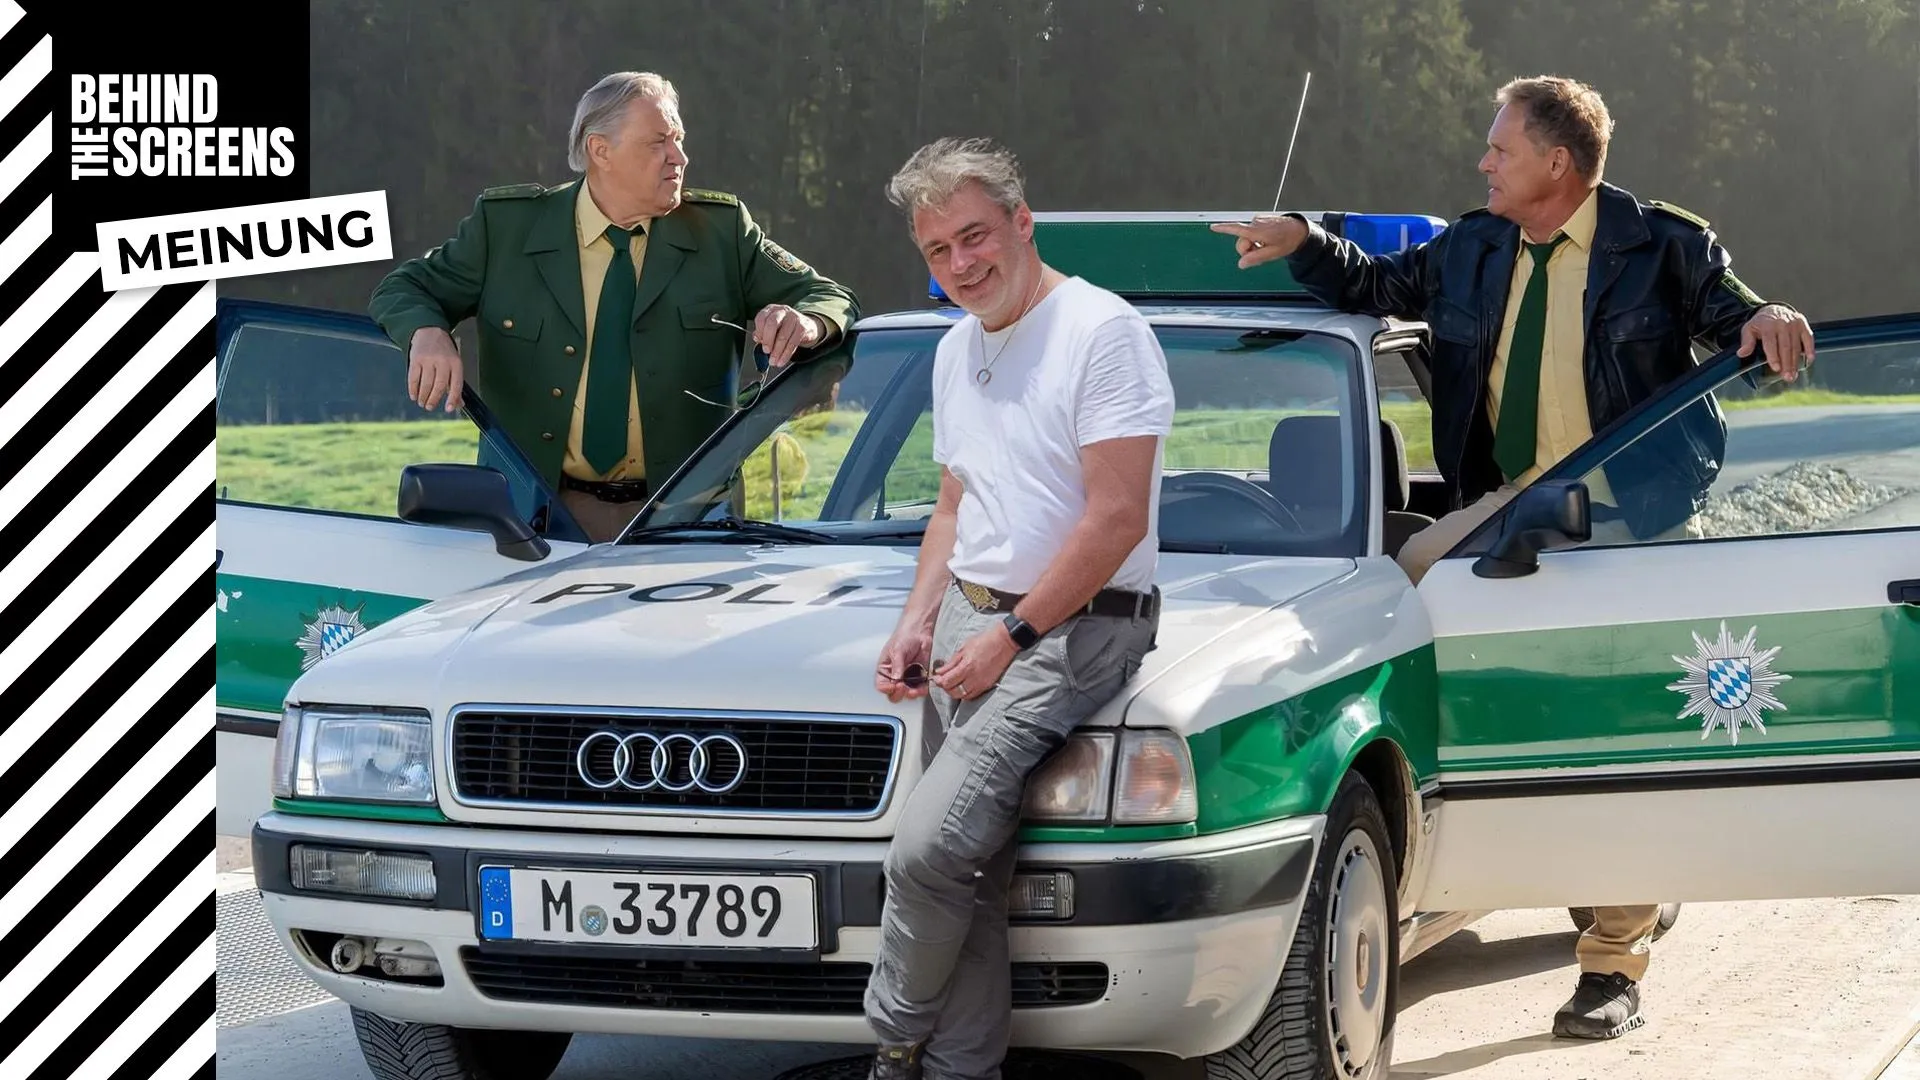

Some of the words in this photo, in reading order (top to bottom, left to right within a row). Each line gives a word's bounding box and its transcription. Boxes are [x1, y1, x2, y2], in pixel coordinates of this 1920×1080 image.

[491, 911, 504, 927] D
[541, 879, 573, 933] M
[612, 881, 782, 938] 33789
